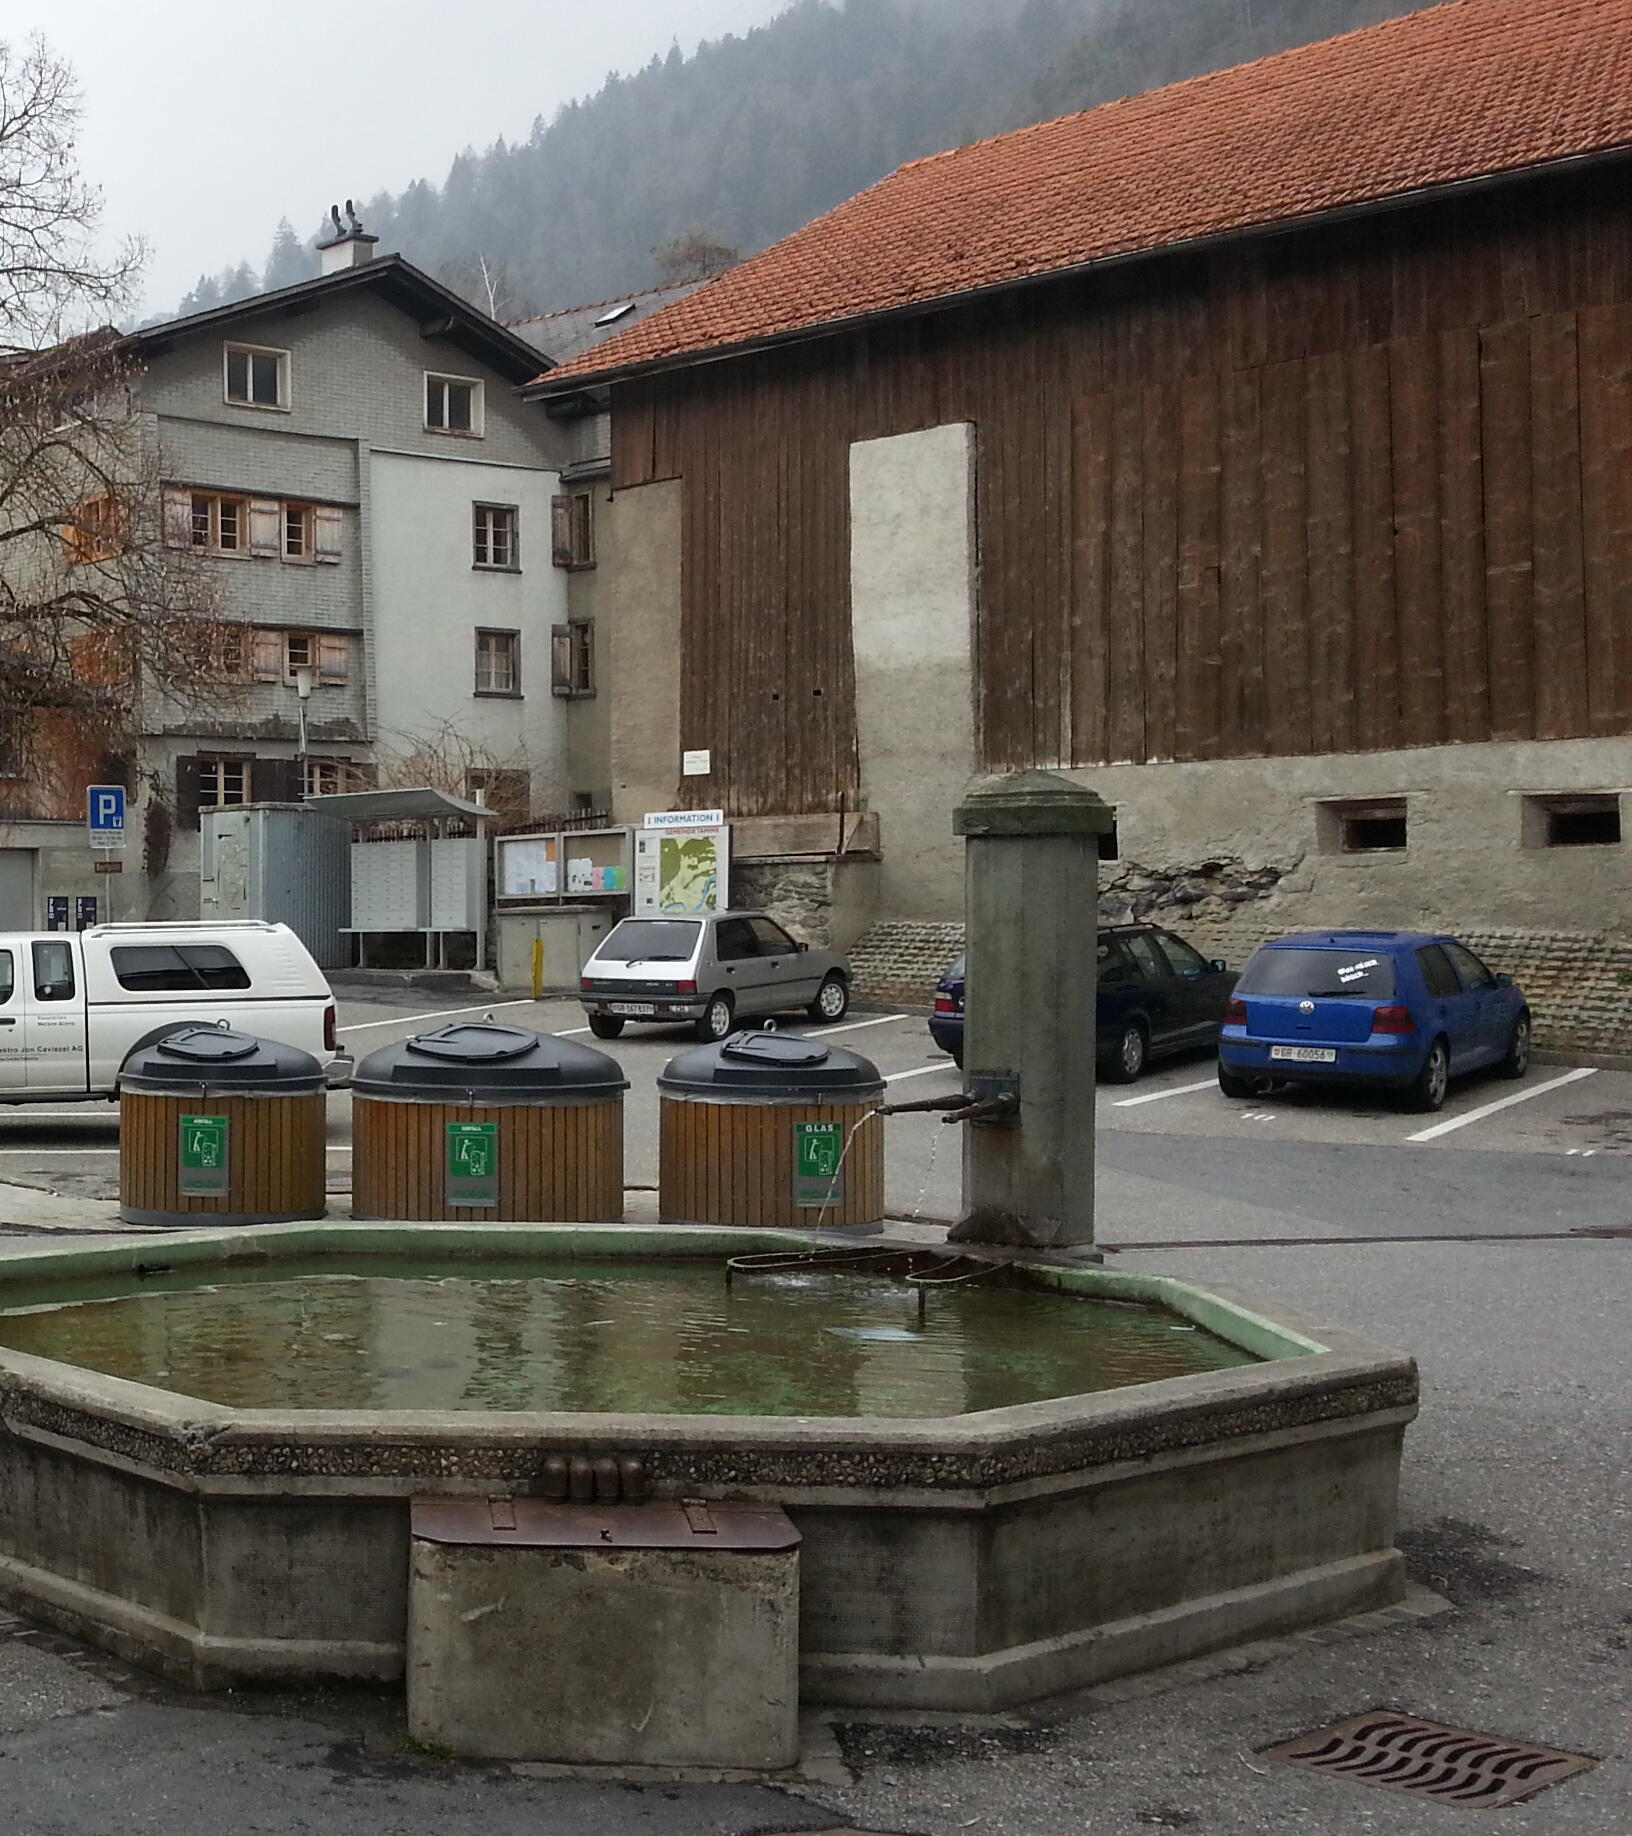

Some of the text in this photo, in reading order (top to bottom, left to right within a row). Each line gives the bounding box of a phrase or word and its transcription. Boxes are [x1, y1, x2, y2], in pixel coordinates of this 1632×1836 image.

[98, 794, 116, 825] P
[653, 814, 713, 825] INFORMATION
[805, 1124, 834, 1133] GLAS
